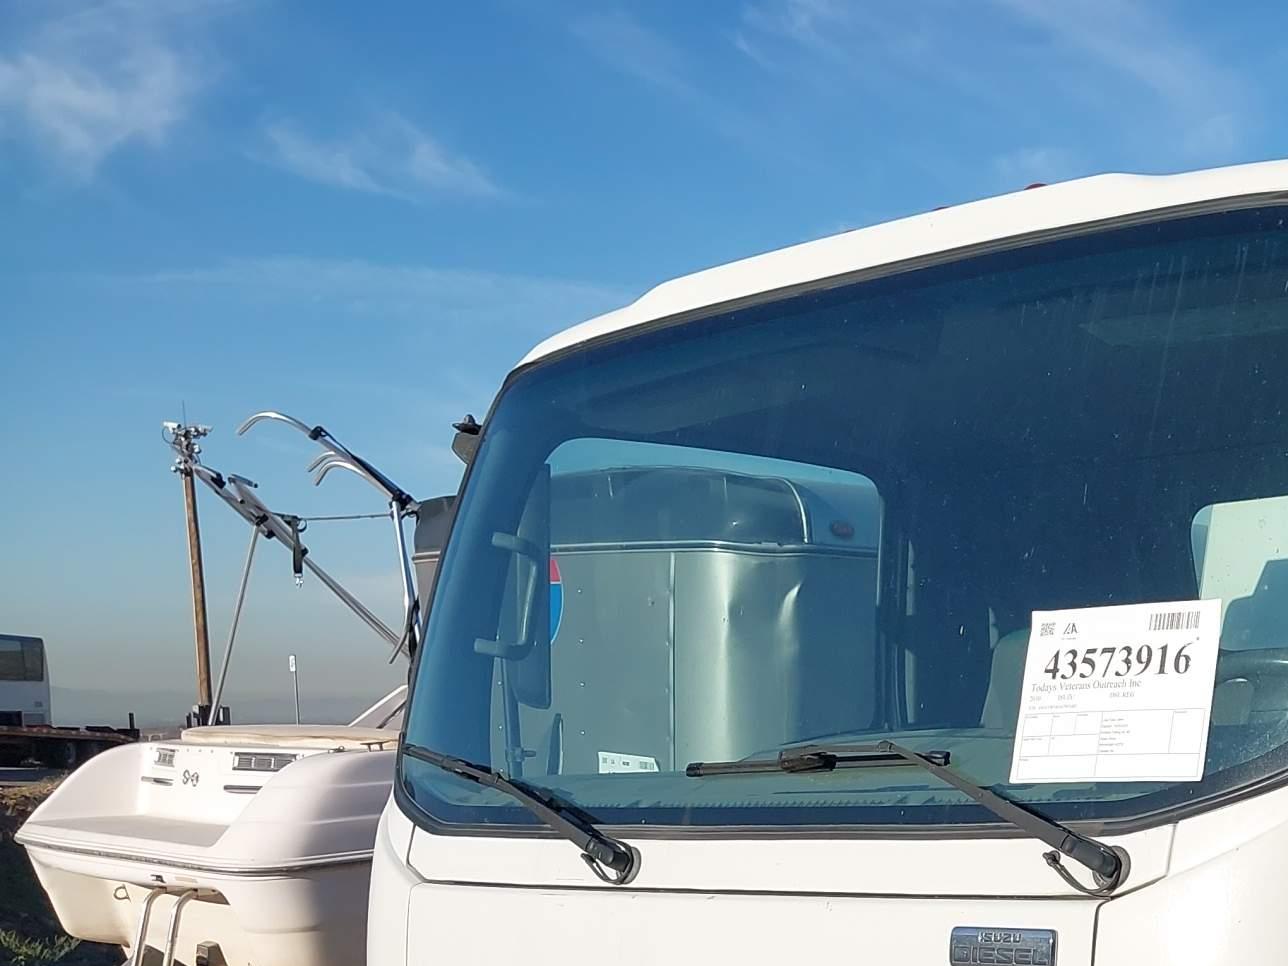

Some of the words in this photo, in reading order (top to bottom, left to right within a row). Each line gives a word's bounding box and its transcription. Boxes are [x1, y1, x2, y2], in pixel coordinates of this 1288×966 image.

[1044, 643, 1192, 680] 43573916
[1031, 683, 1057, 694] Todays
[1060, 681, 1091, 691] Veterans
[1093, 679, 1127, 690] Outreach
[1129, 679, 1142, 688] Inc
[978, 931, 1023, 944] ISUZU
[953, 945, 1050, 966] DIESEL
